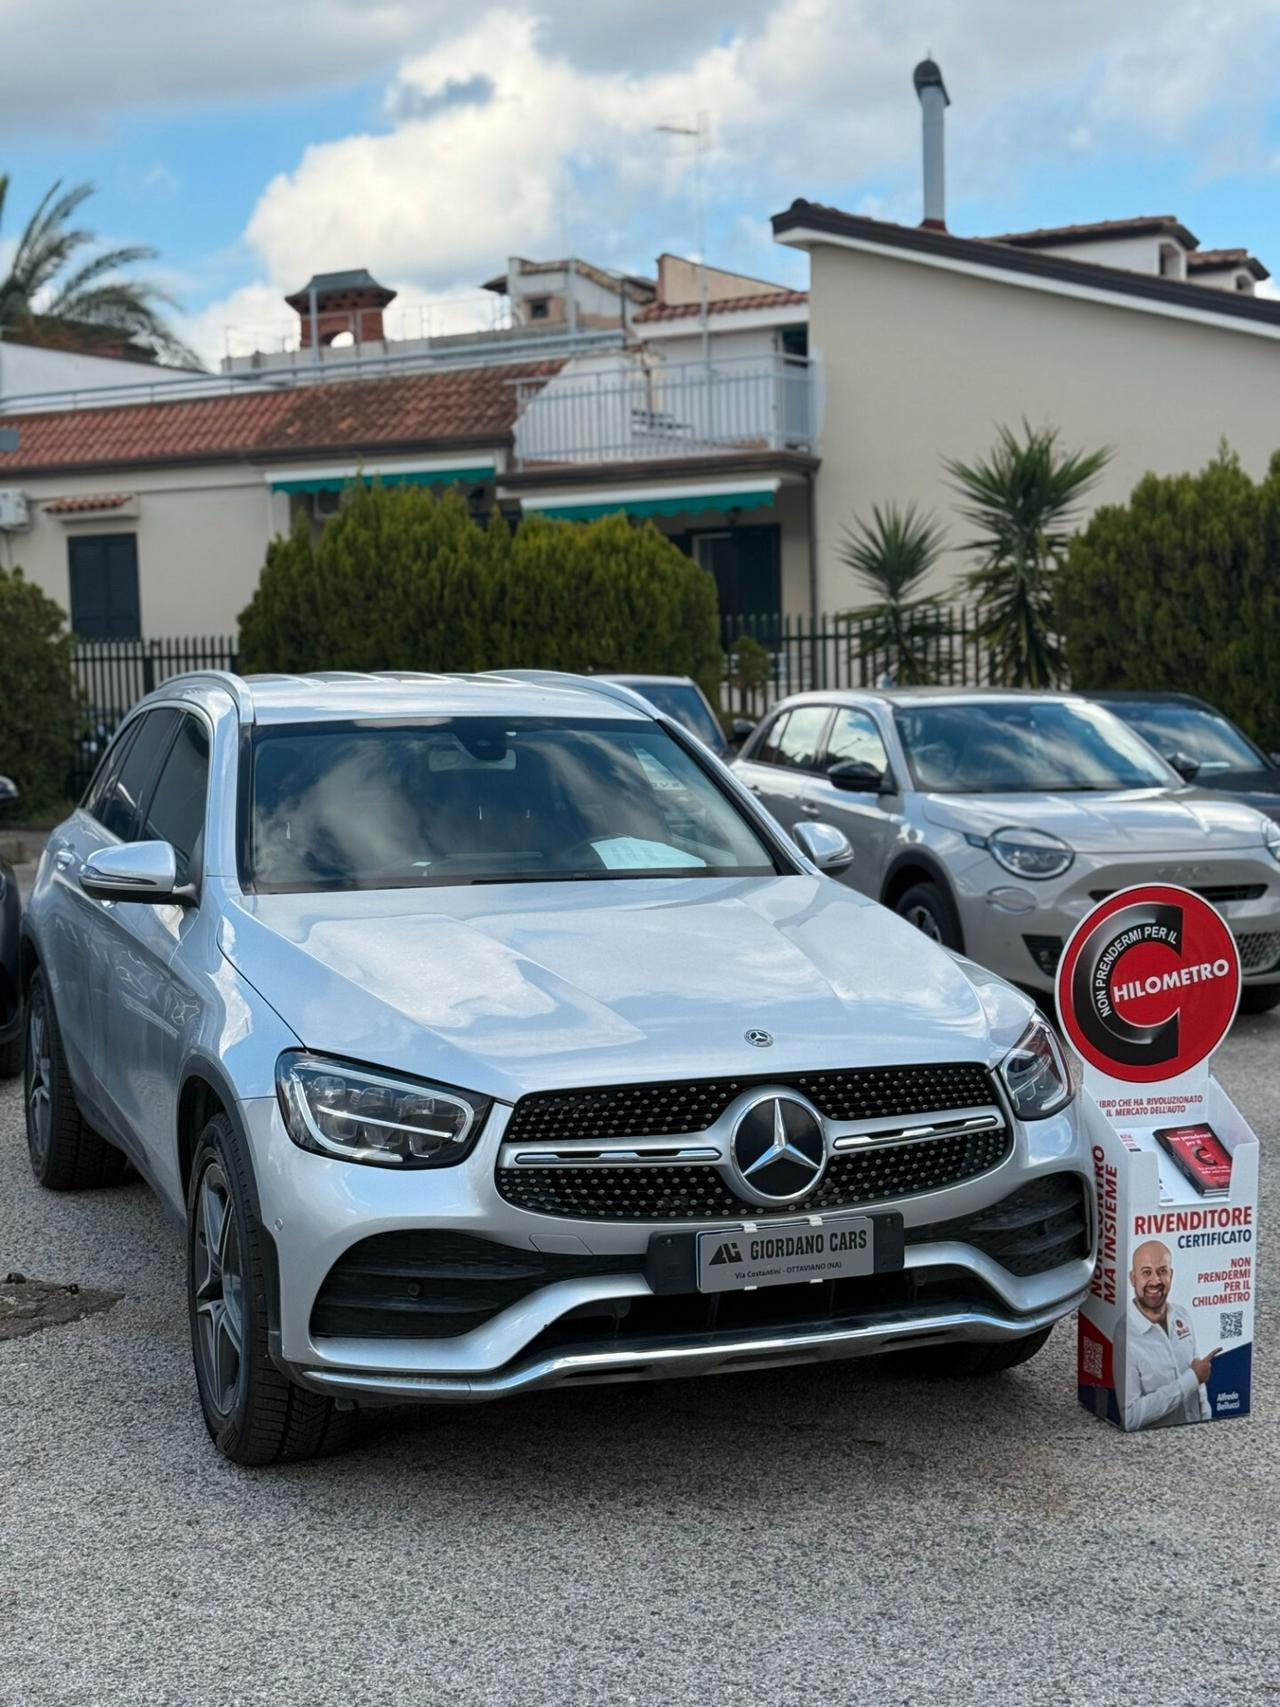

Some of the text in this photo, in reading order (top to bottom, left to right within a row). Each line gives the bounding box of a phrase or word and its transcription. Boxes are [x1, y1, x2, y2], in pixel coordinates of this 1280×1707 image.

[1095, 926, 1177, 1017] NON PRENDERMI PER IL
[1097, 1095, 1204, 1109] IBRO CHE HA RIVOLUZIONATO
[1115, 1107, 1149, 1117] MERCATO
[1149, 1105, 1186, 1115] DELL'AUTO
[1134, 1206, 1253, 1235] RIVENDITORE
[1103, 1164, 1118, 1305] MA INSIEME
[1177, 1229, 1252, 1249] CERTIFICATO
[750, 1234, 824, 1260] GIORDANO
[829, 1229, 867, 1252] CARS
[735, 1271, 746, 1279] Via
[746, 1268, 781, 1278] Costantini
[786, 1263, 826, 1273] OTTAVIANO
[827, 1261, 842, 1269] (NA)
[1230, 1257, 1251, 1268] NON
[1197, 1269, 1251, 1283] PRENDERMI
[1224, 1280, 1251, 1292] PER IL
[1192, 1291, 1250, 1307] CHILOMETRO
